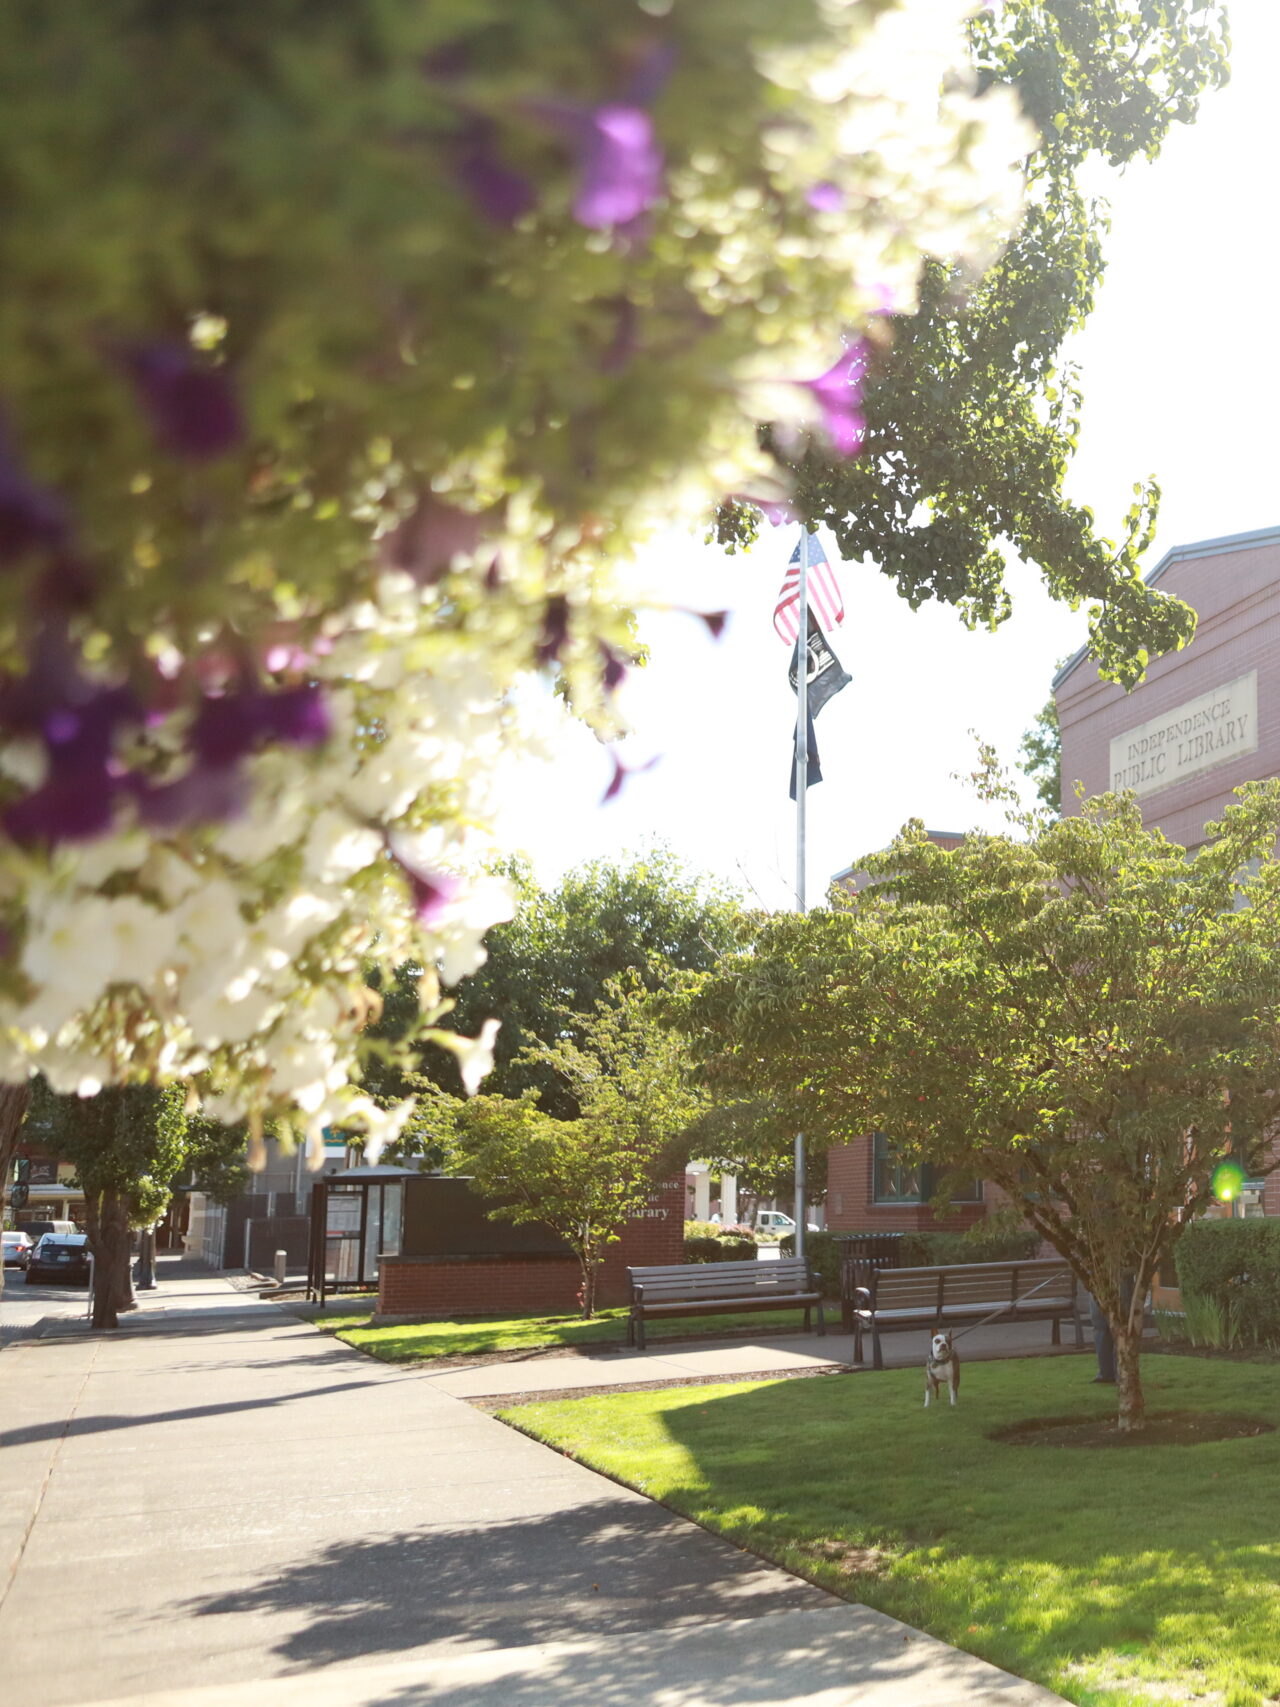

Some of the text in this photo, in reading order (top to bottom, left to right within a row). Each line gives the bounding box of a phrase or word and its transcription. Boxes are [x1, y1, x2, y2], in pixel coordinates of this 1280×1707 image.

[1114, 713, 1249, 794] PUBLIC LIBRARY
[1127, 698, 1231, 760] INDEPENDENCE
